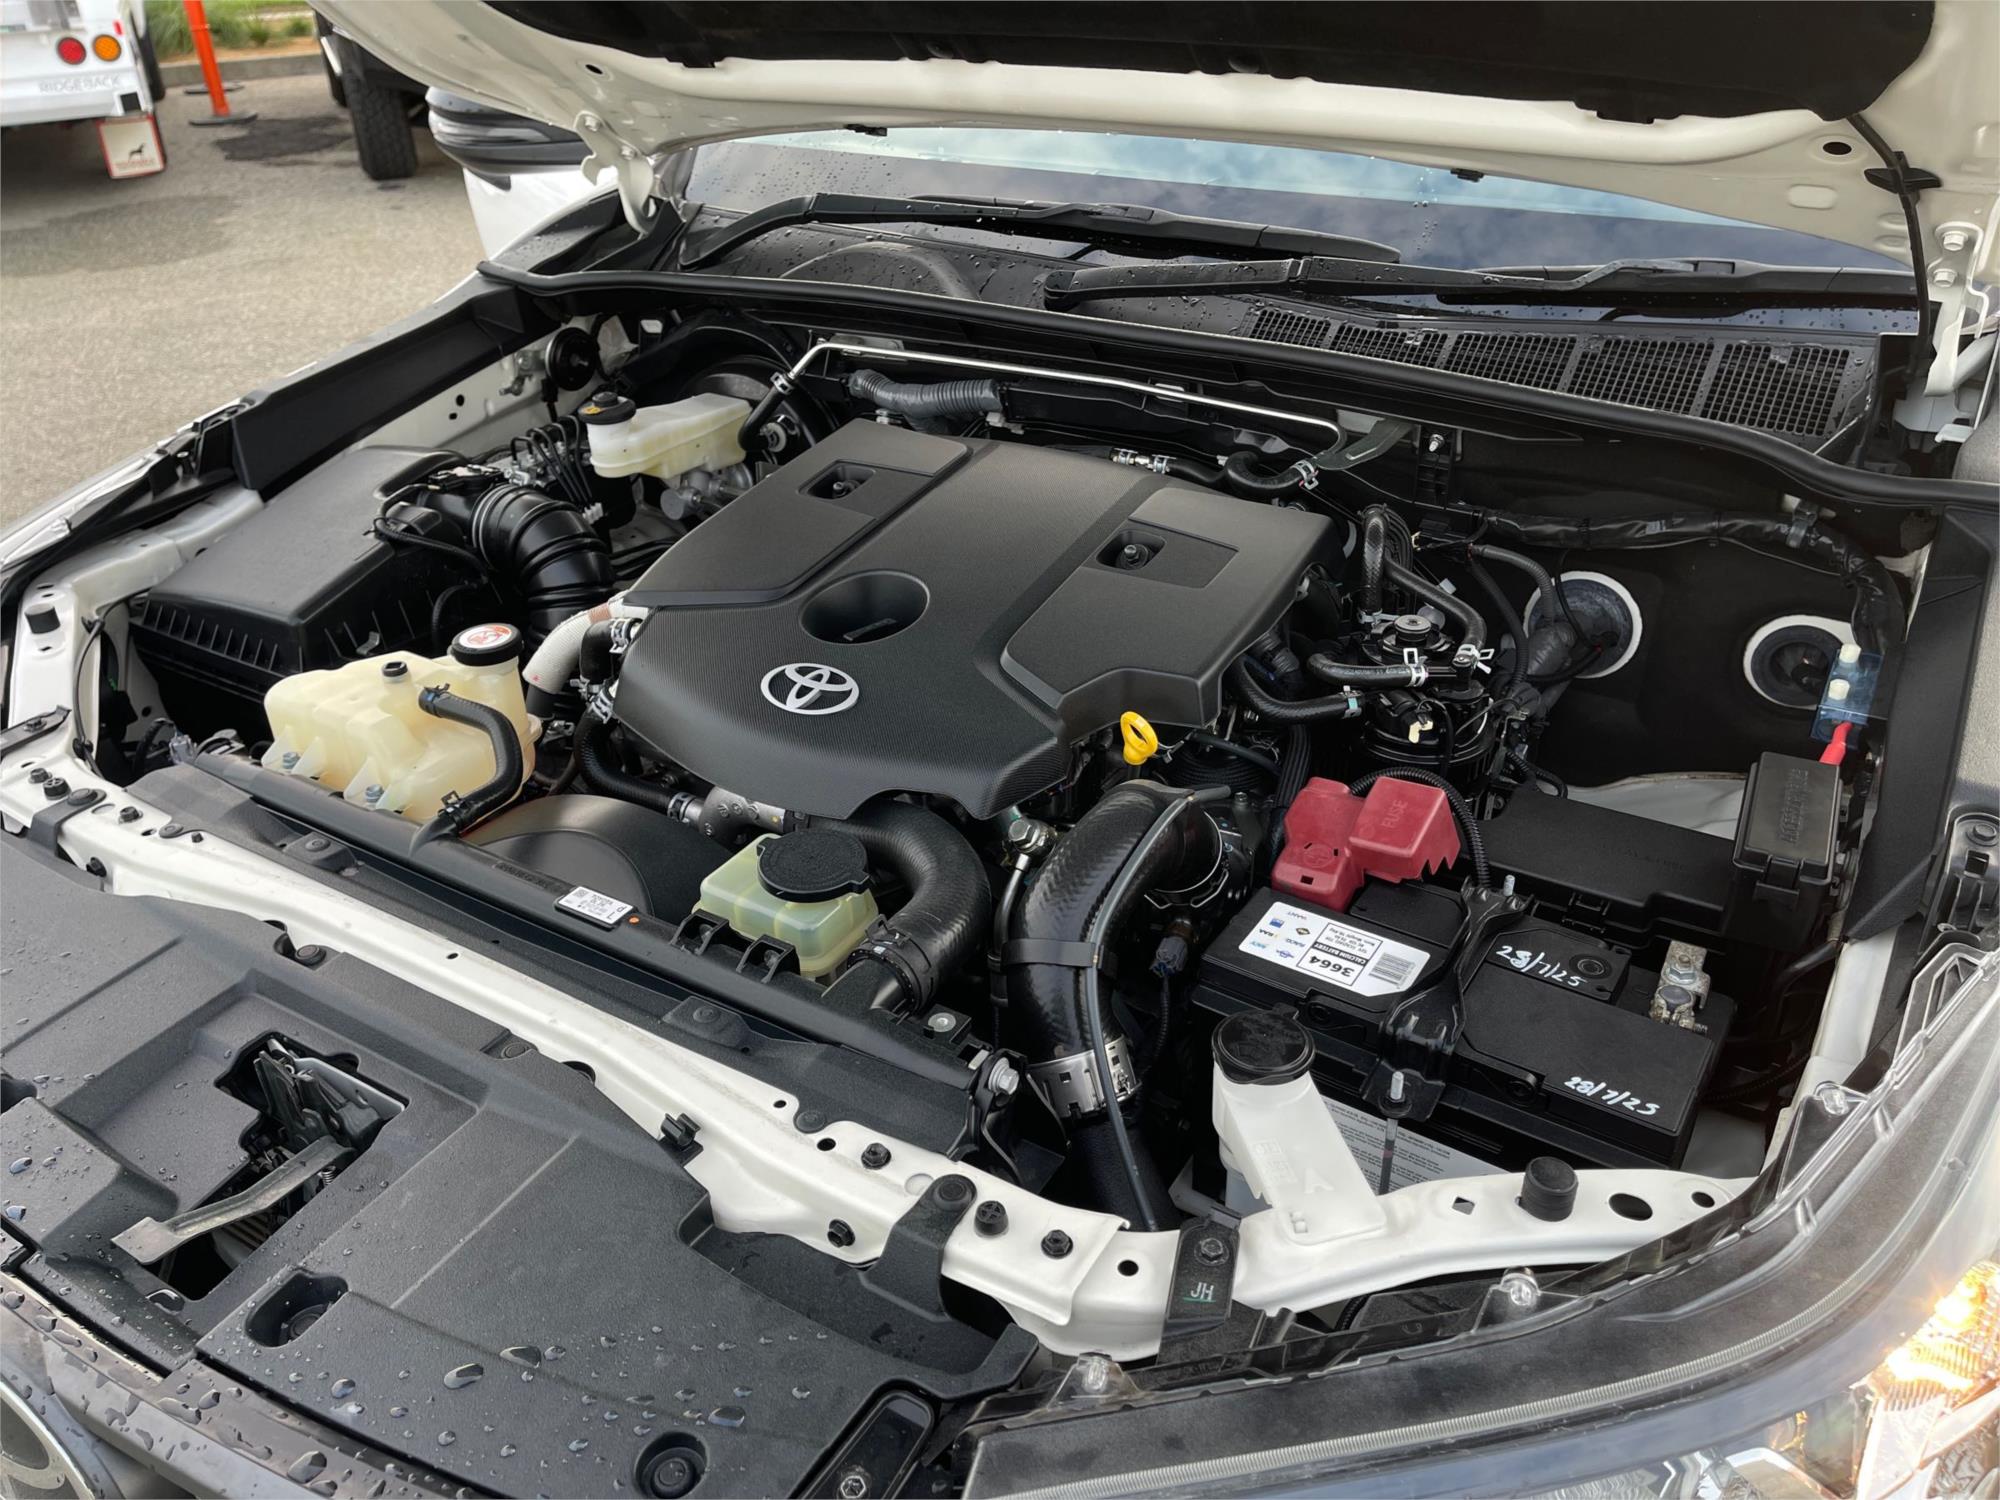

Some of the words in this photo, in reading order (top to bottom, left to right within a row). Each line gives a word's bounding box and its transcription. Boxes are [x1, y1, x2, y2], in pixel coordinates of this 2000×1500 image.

[39, 75, 121, 93] RIDGEBACK
[1381, 799, 1408, 829] FUSE
[1313, 942, 1341, 956] BATTERY
[1339, 951, 1367, 965] CALCIUM
[1309, 955, 1355, 977] 3664
[1564, 1076, 1661, 1116] 28/7/25
[1190, 1282, 1214, 1301] JH
